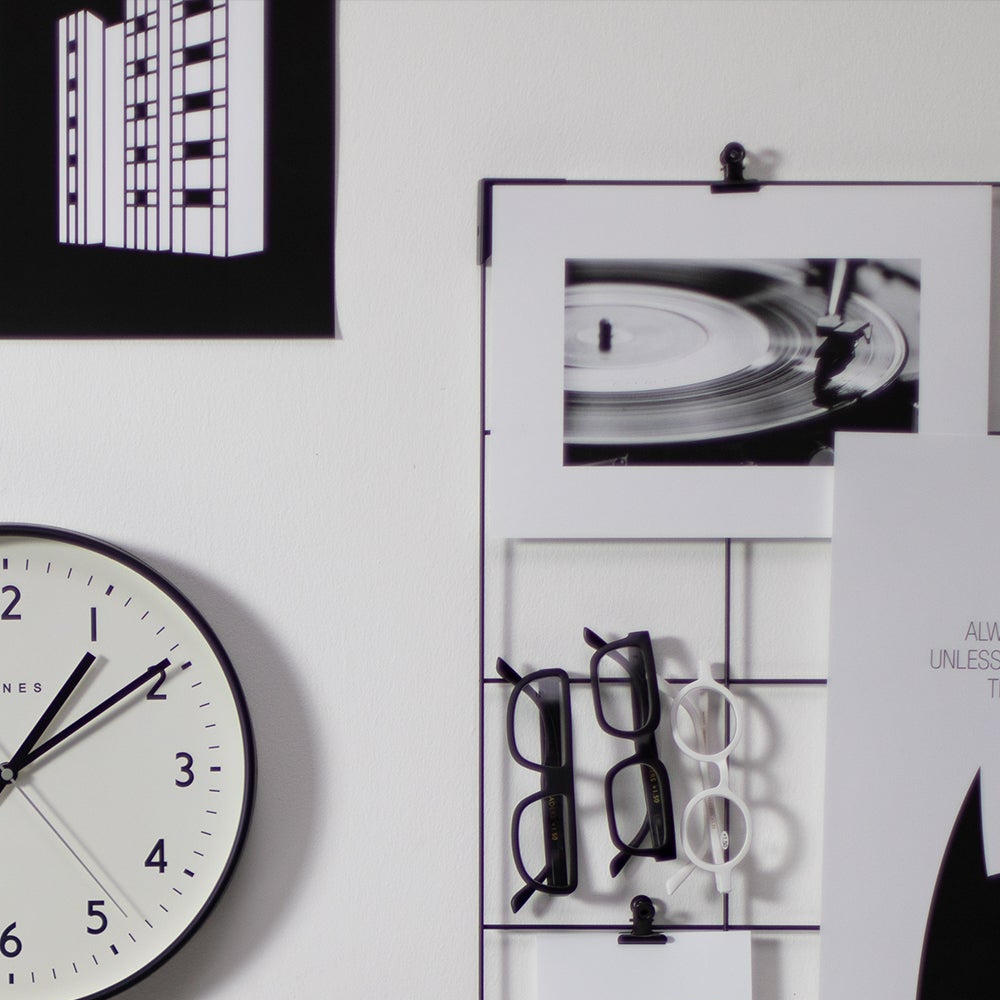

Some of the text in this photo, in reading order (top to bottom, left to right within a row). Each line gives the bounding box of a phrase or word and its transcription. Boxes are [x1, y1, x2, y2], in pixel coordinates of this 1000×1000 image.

[90, 607, 97, 641] 1
[146, 666, 168, 700] 2
[175, 752, 195, 788] 3
[144, 838, 168, 873] 4
[86, 900, 108, 935] 5
[0, 922, 22, 958] 6
